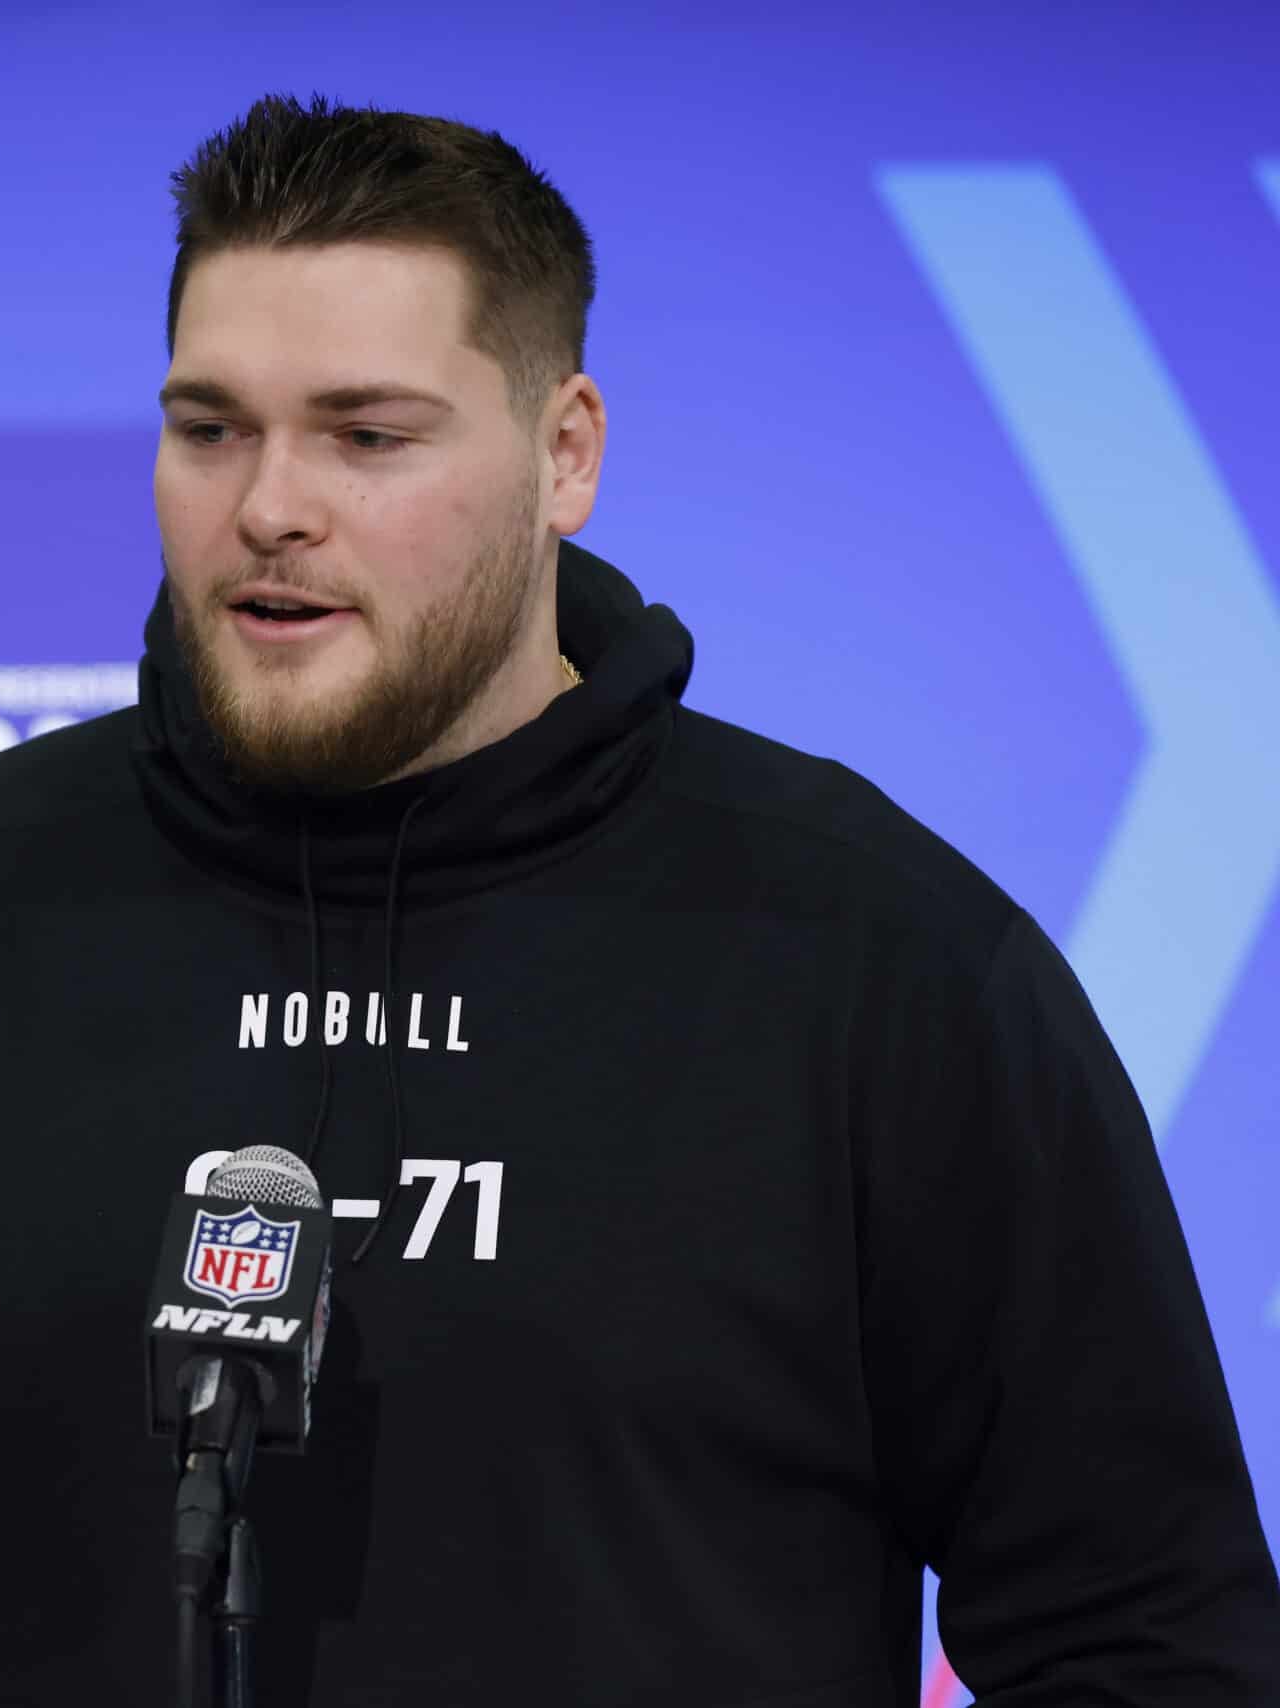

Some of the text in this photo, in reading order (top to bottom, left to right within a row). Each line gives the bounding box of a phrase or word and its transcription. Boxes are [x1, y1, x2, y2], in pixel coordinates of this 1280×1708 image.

[238, 991, 470, 1051] NOBULL
[197, 1247, 276, 1292] NFL
[152, 1304, 302, 1343] NFLN
